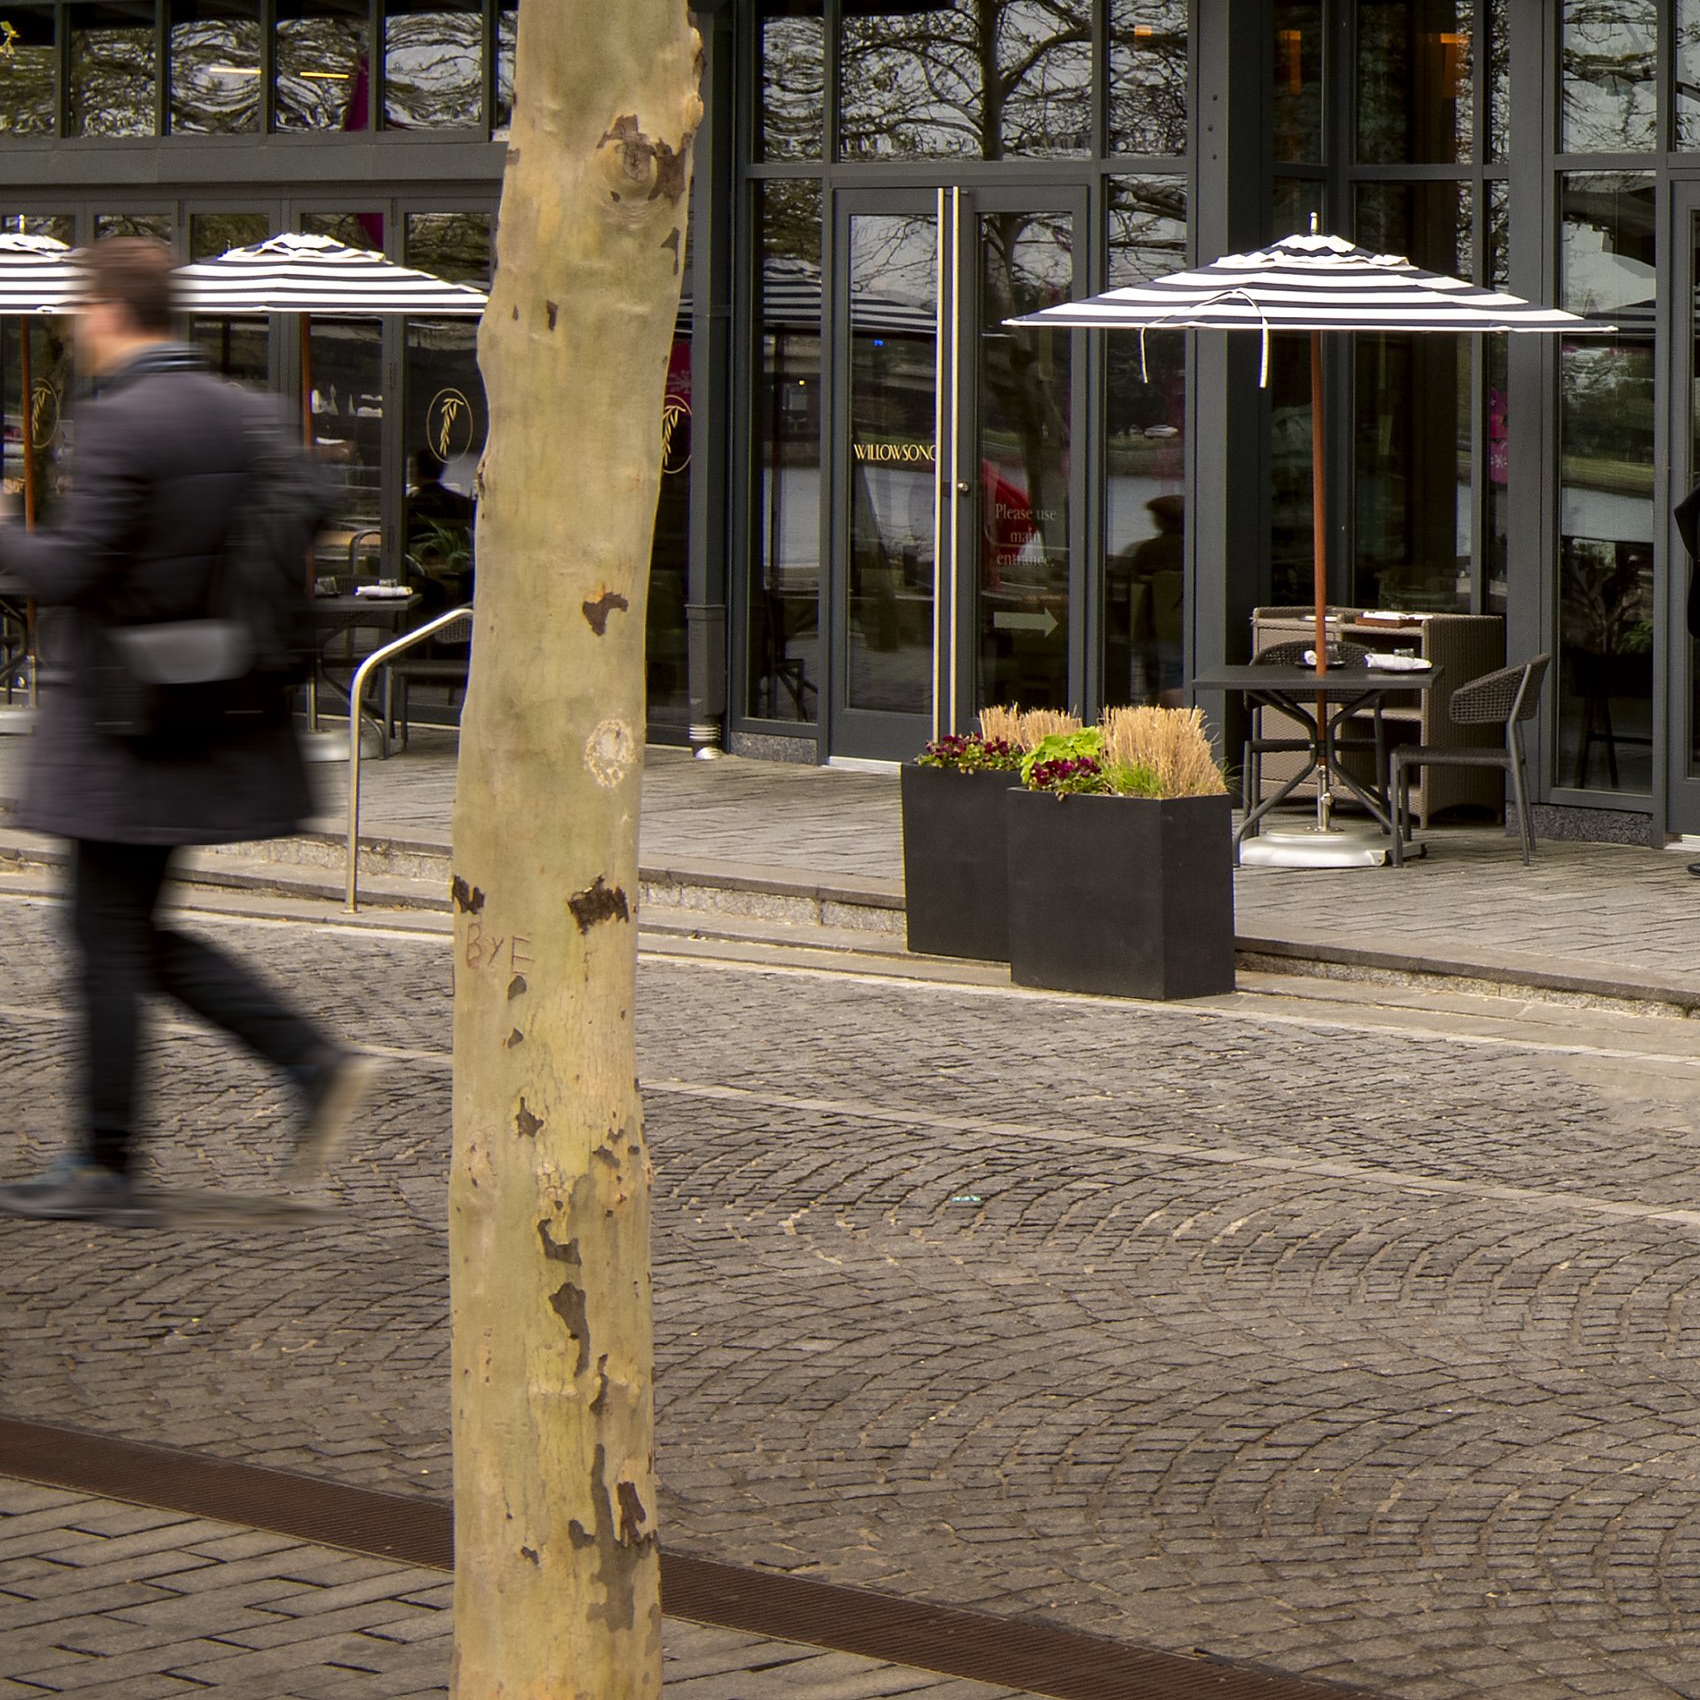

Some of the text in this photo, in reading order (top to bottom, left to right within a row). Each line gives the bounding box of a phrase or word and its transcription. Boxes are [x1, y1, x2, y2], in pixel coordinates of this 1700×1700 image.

[995, 503, 1057, 521] Please use
[1010, 525, 1041, 543] main
